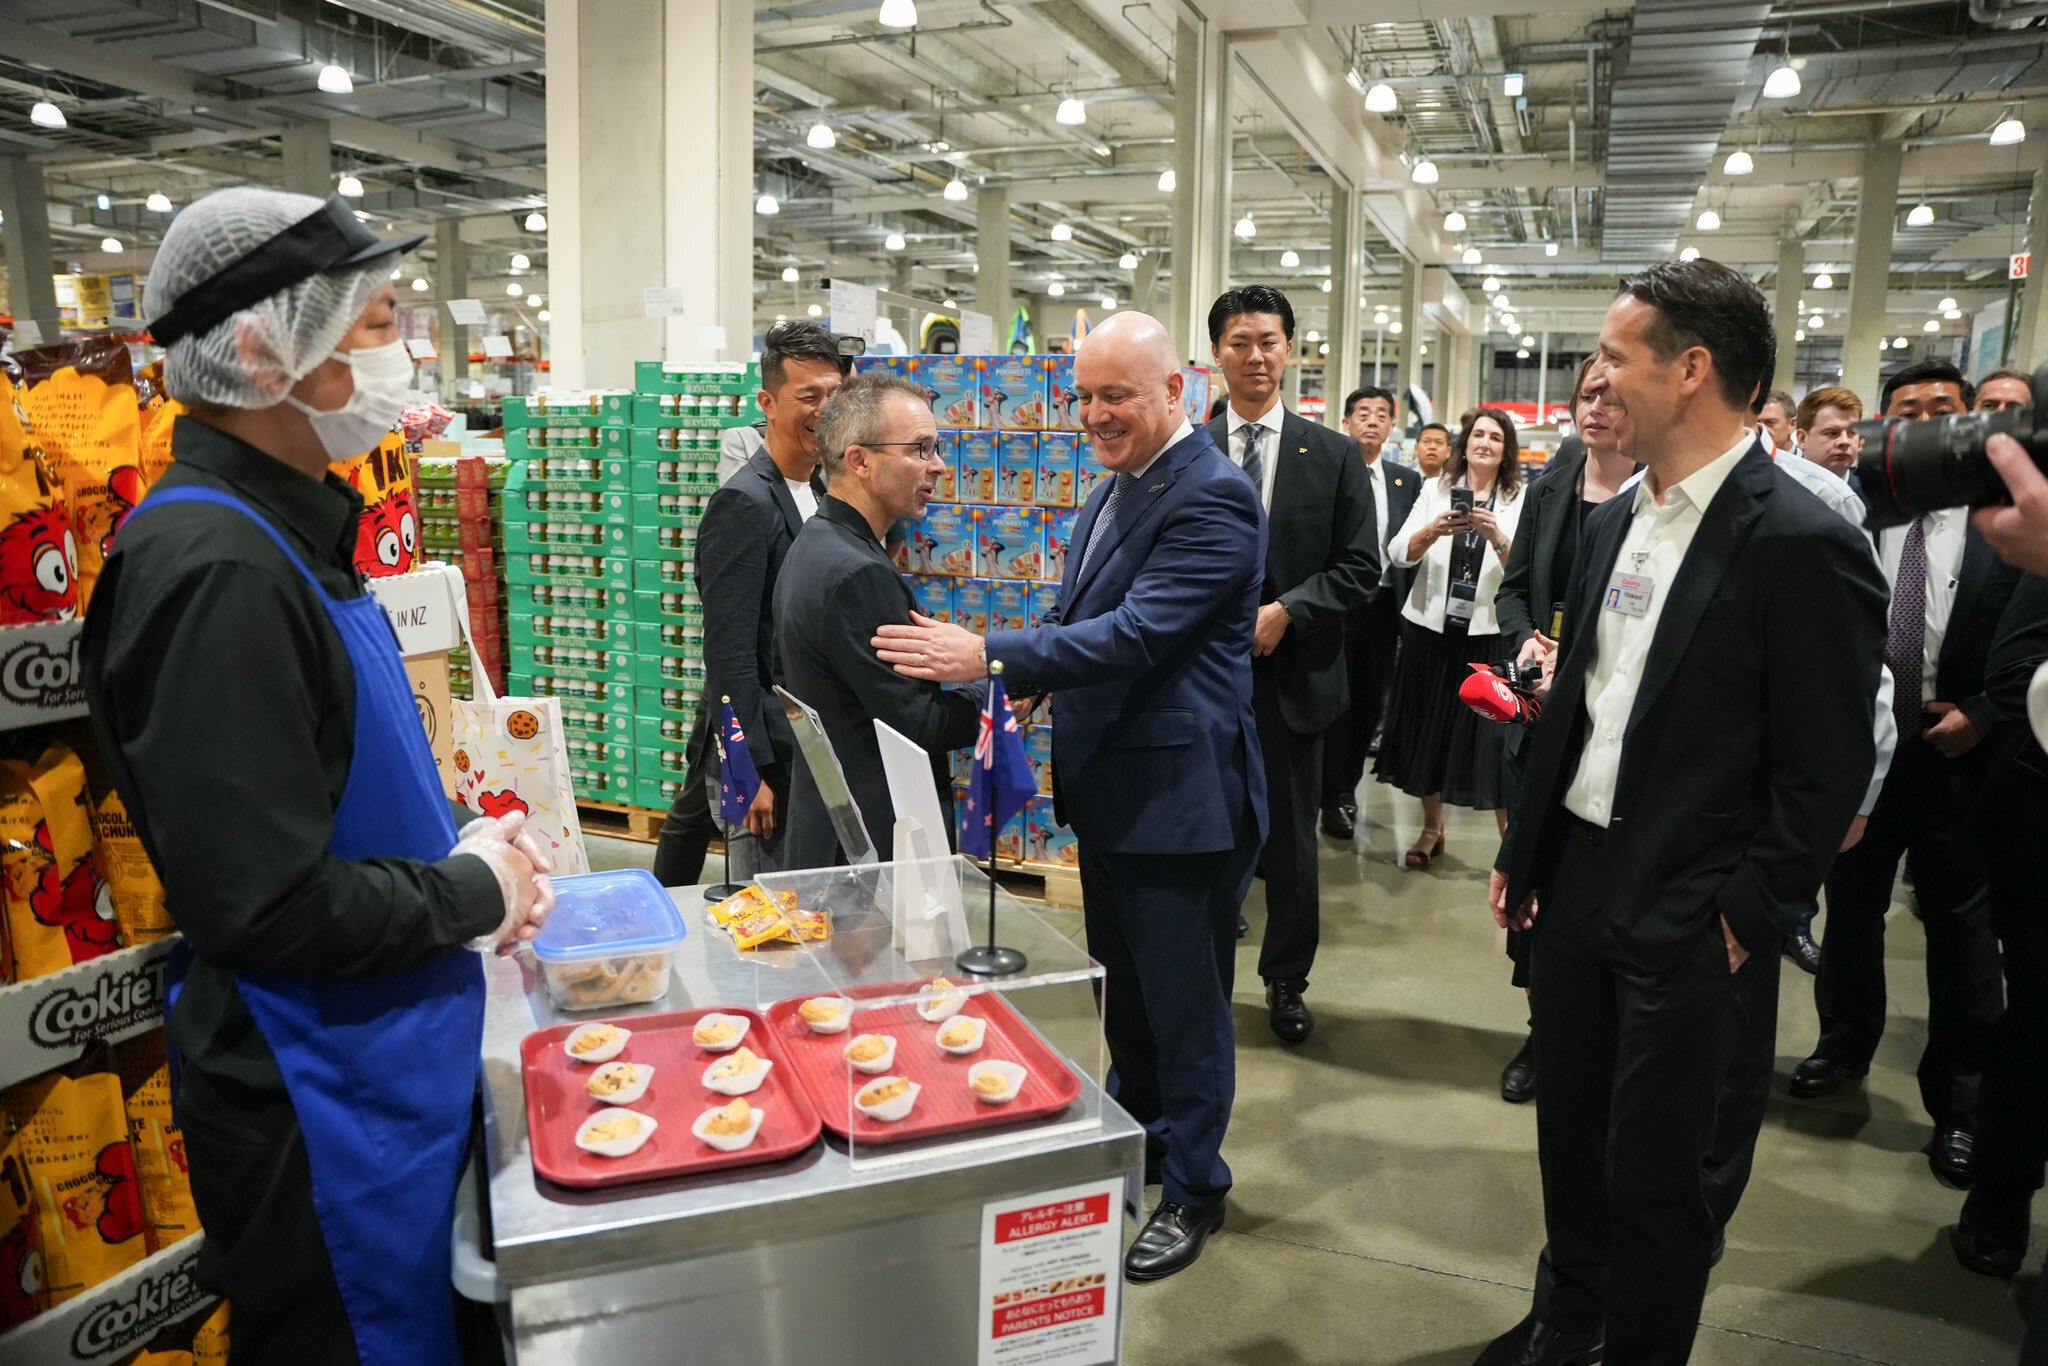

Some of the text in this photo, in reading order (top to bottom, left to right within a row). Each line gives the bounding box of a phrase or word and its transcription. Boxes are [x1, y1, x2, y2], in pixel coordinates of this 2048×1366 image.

[690, 384, 722, 394] XYLITOL
[690, 418, 722, 428] XYLITOL
[687, 453, 719, 462] XYLITOL
[397, 606, 427, 628] IN NZ
[73, 1030, 91, 1043] For
[94, 1014, 132, 1037] Serious
[1008, 1212, 1096, 1239] ALLERGY ALERT
[1002, 1304, 1095, 1334] PARENTS NOTICE
